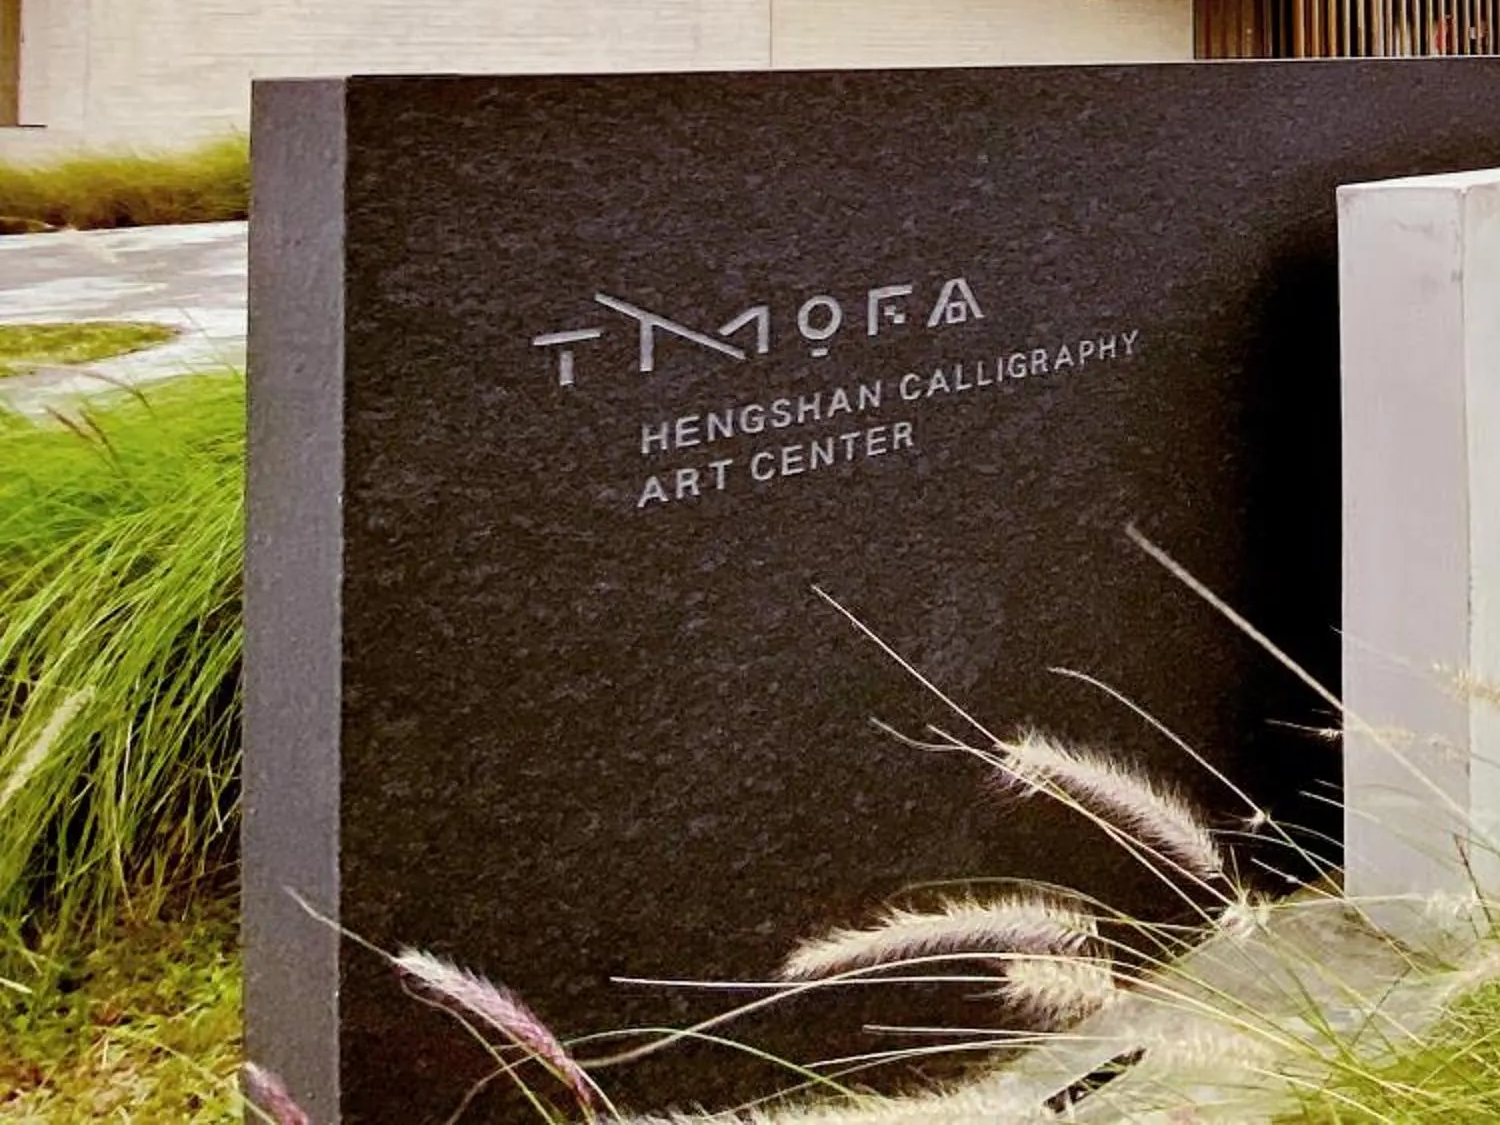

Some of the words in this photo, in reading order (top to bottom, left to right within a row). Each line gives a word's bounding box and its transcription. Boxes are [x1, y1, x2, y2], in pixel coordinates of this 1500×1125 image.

[640, 380, 882, 454] HENGSHAN
[899, 330, 1139, 401] CALLIGRAPHY
[637, 461, 733, 507] ART
[750, 422, 914, 480] CENTER
